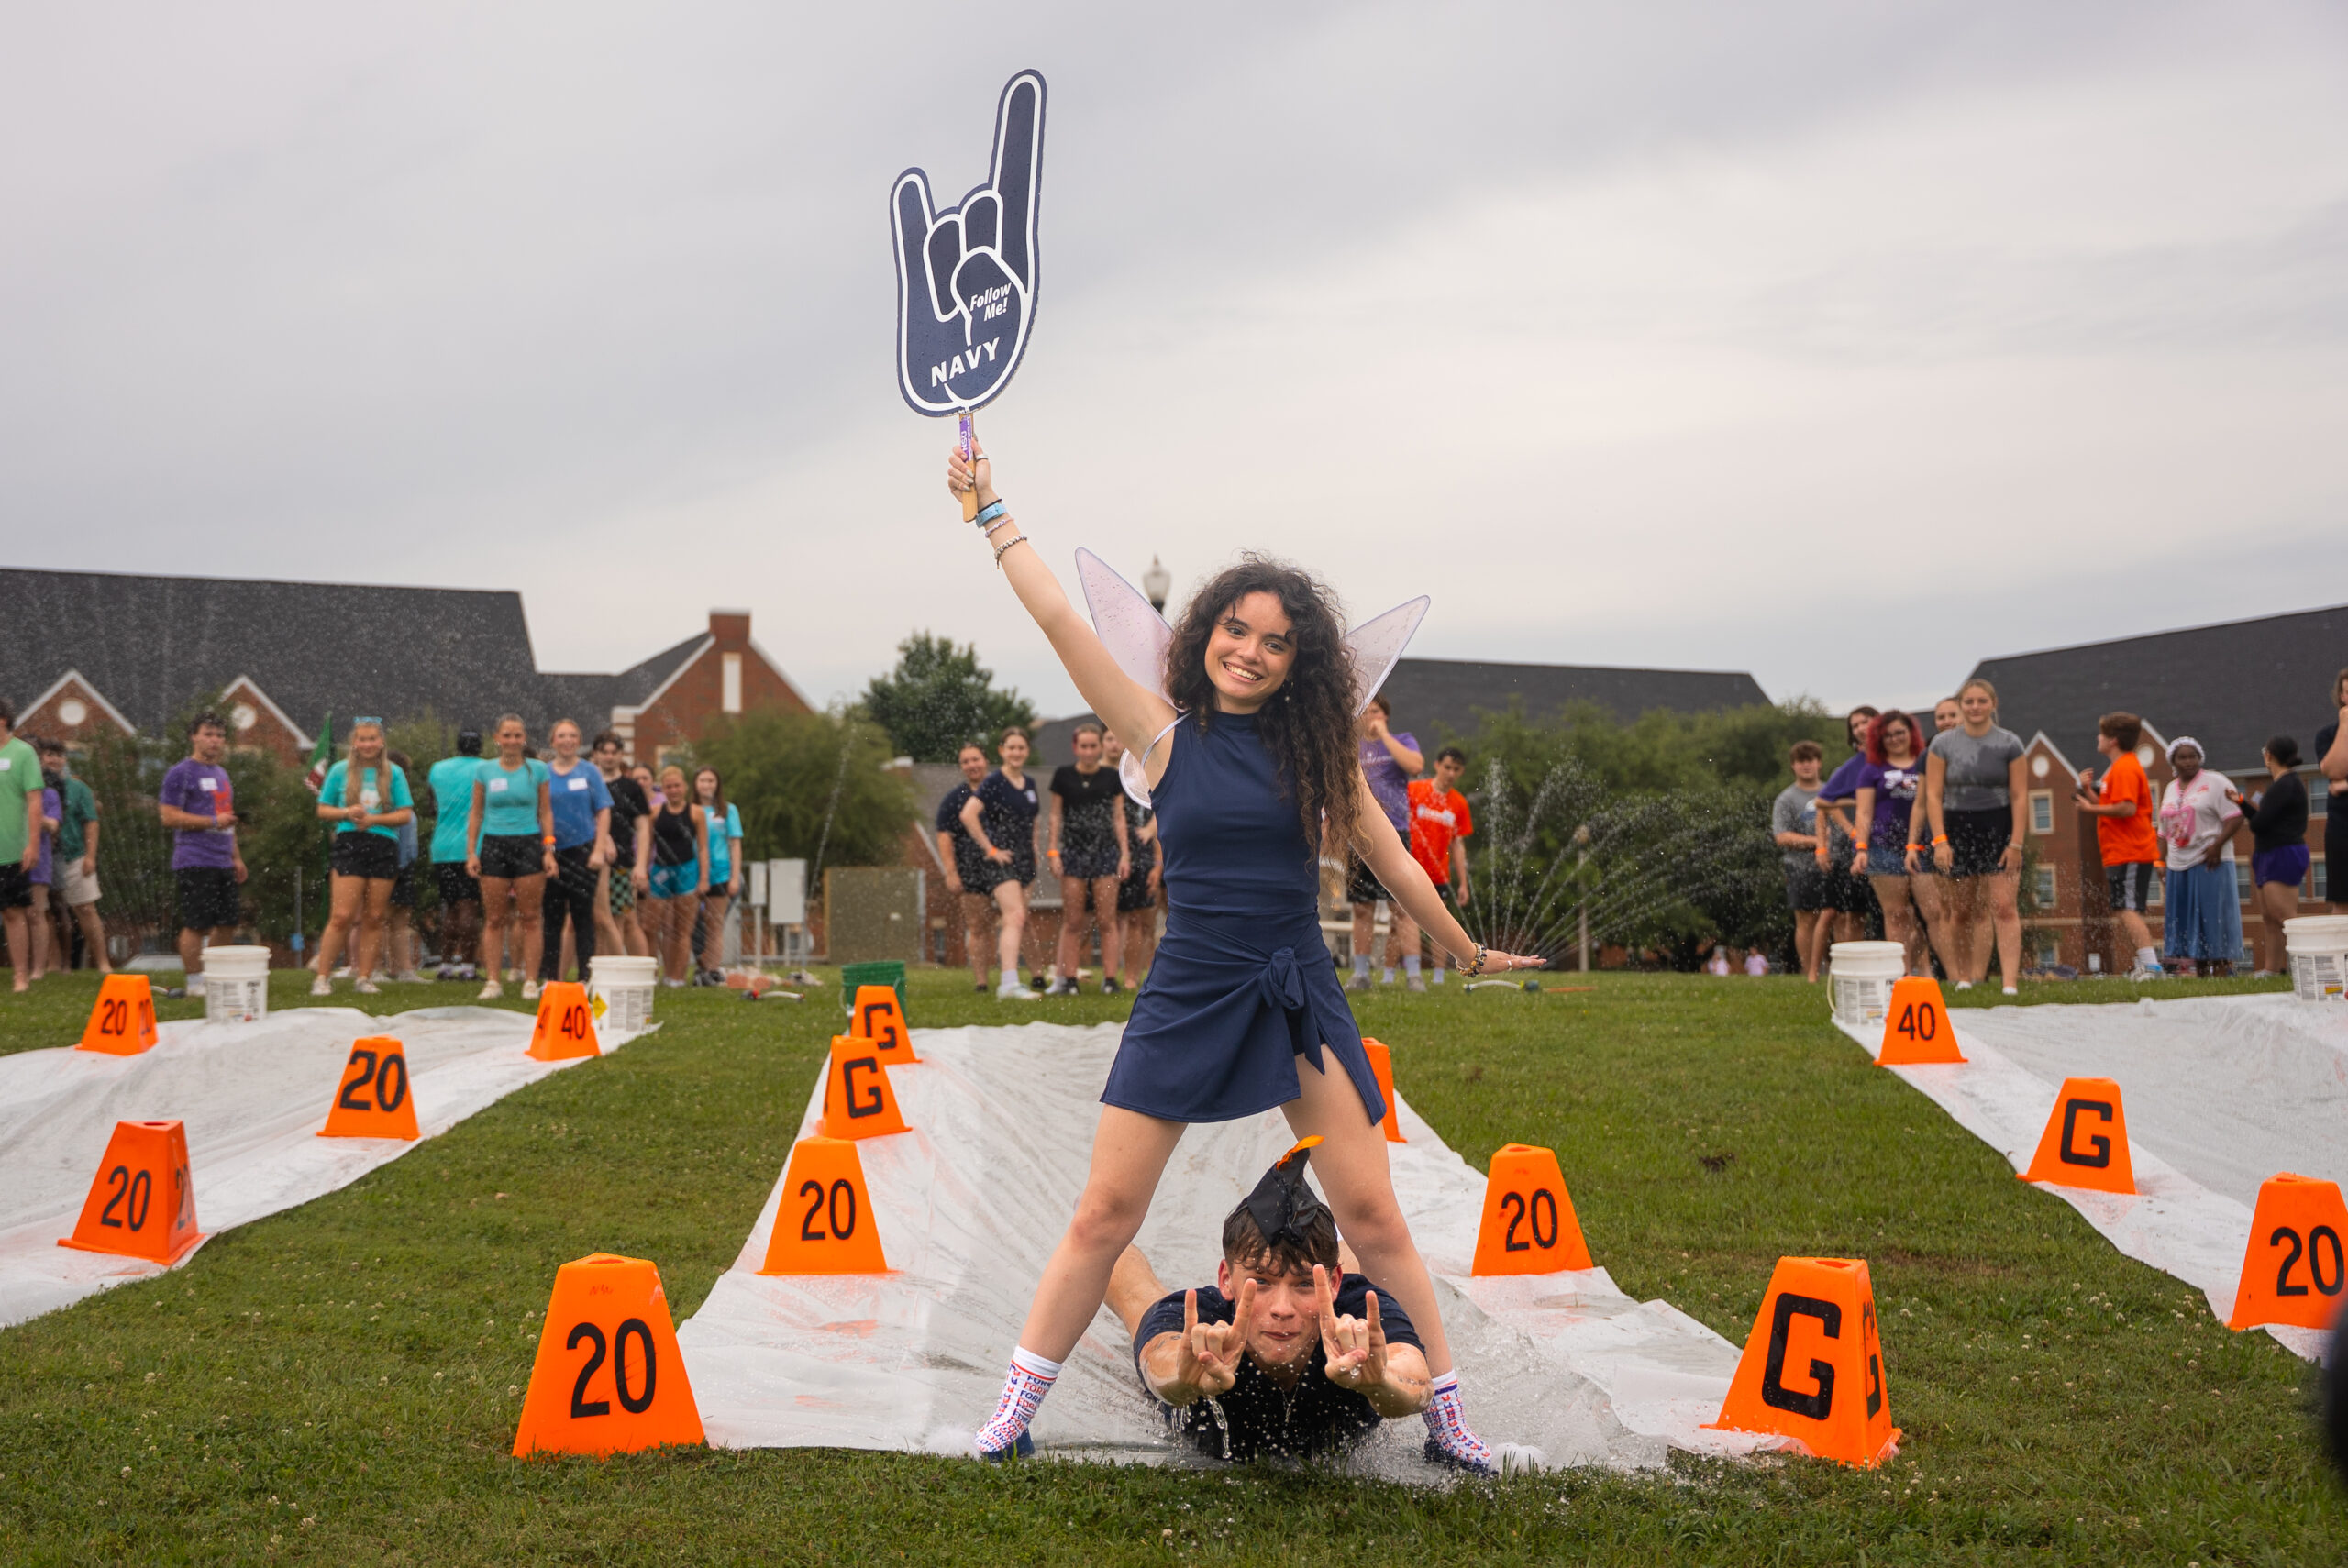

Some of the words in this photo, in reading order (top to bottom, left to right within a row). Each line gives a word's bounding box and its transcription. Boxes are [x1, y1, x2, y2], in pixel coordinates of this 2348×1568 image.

[969, 282, 1013, 312] Follow
[983, 296, 1008, 322] Me!
[931, 337, 1000, 388] NAVY
[100, 998, 127, 1036] 20
[561, 1005, 586, 1040] 40
[864, 1002, 897, 1051] G
[1898, 1002, 1936, 1041] 40
[338, 1049, 408, 1113] 20
[843, 1056, 883, 1119] G
[2060, 1098, 2113, 1168] G
[100, 1165, 152, 1232] 20
[799, 1178, 856, 1242] 20
[1501, 1188, 1558, 1253] 20
[2269, 1224, 2345, 1297] 20
[566, 1318, 657, 1419] 20
[1761, 1291, 1842, 1421] G
